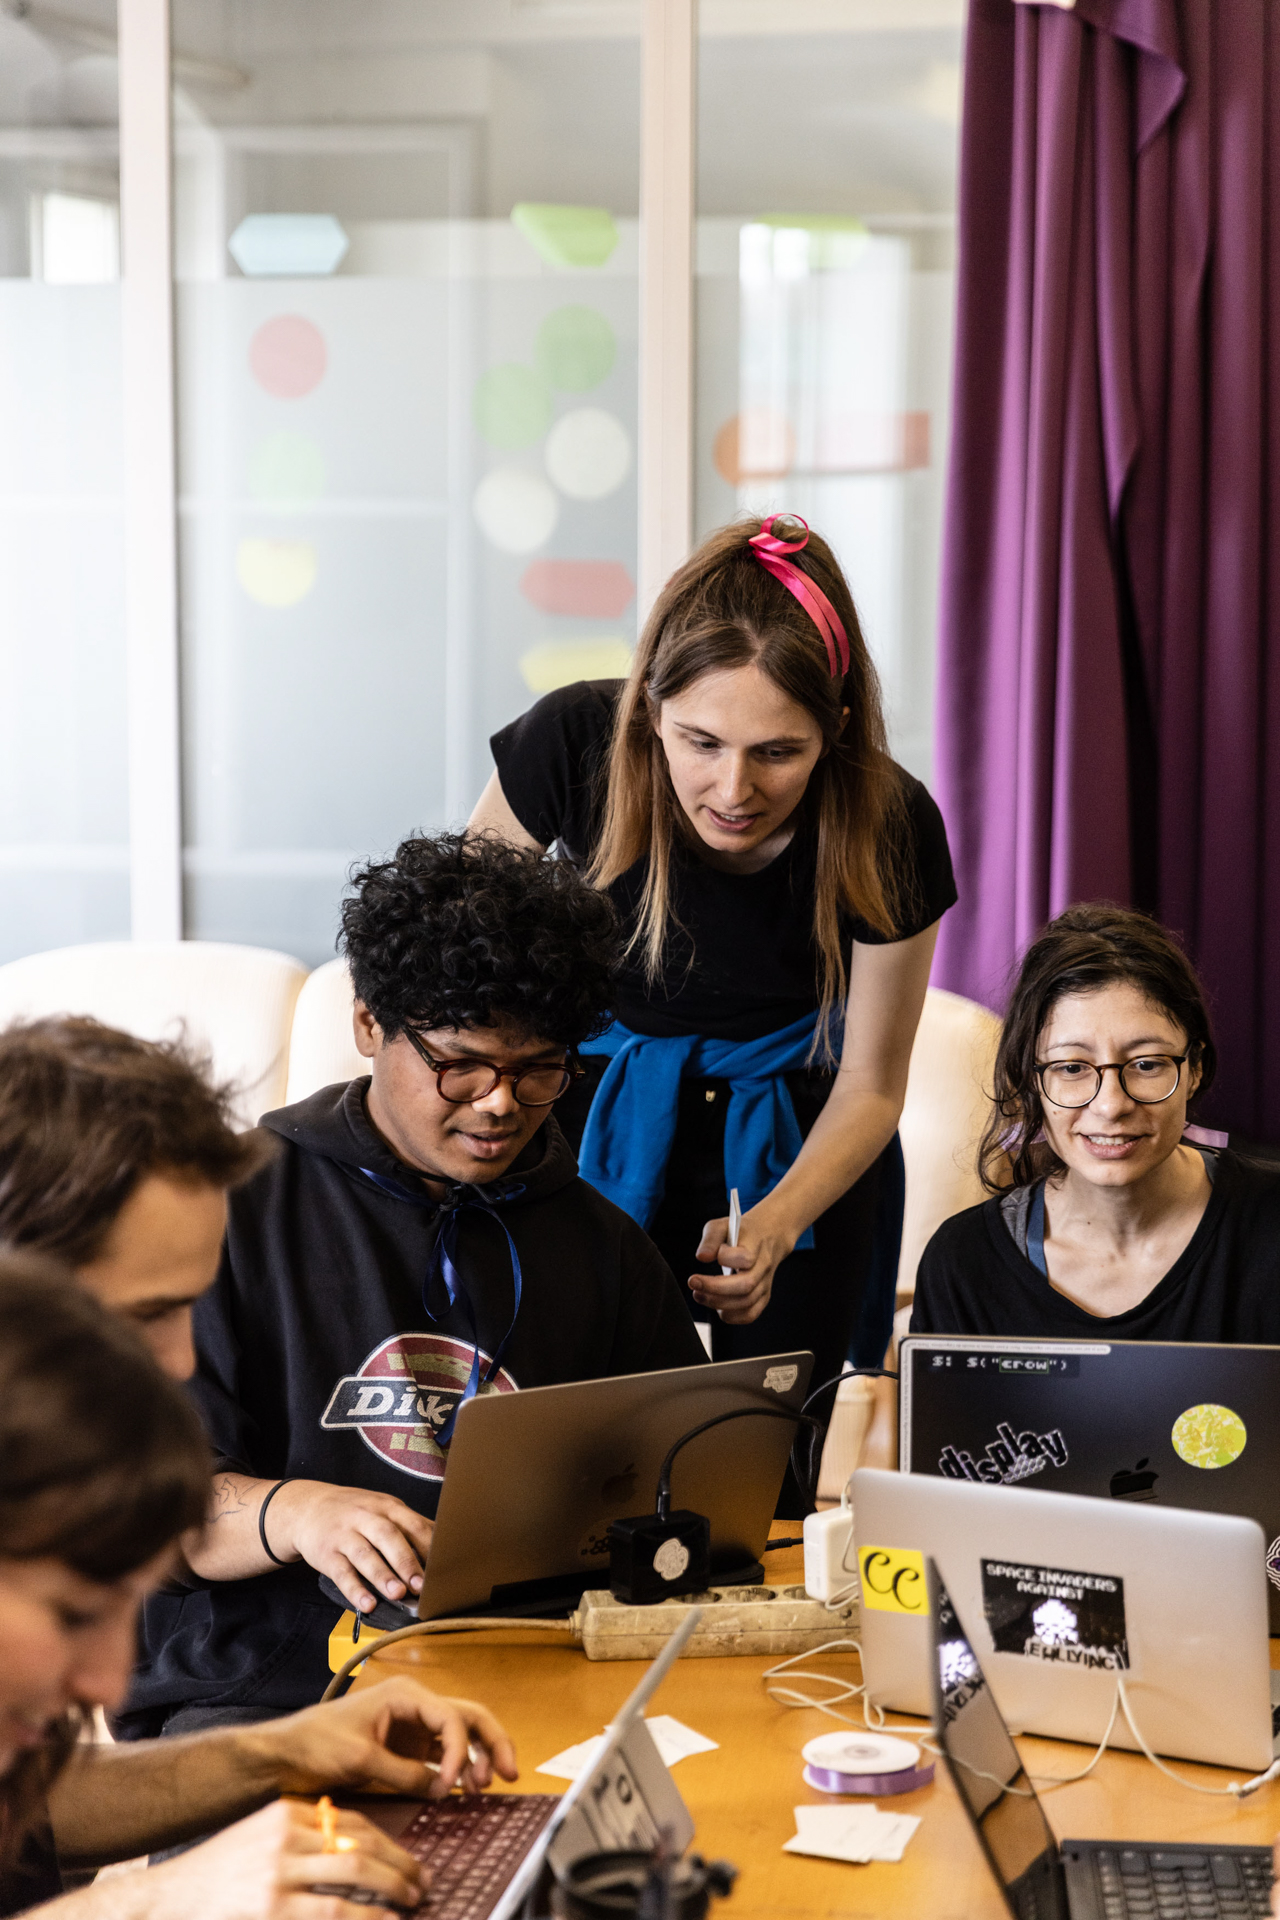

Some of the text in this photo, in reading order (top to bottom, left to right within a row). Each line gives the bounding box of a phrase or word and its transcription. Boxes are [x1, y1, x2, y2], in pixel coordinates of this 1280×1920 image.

[938, 1421, 1068, 1485] display
[986, 1563, 1118, 1593] SPACE INVADERS
[1016, 1580, 1085, 1600] AGAINST
